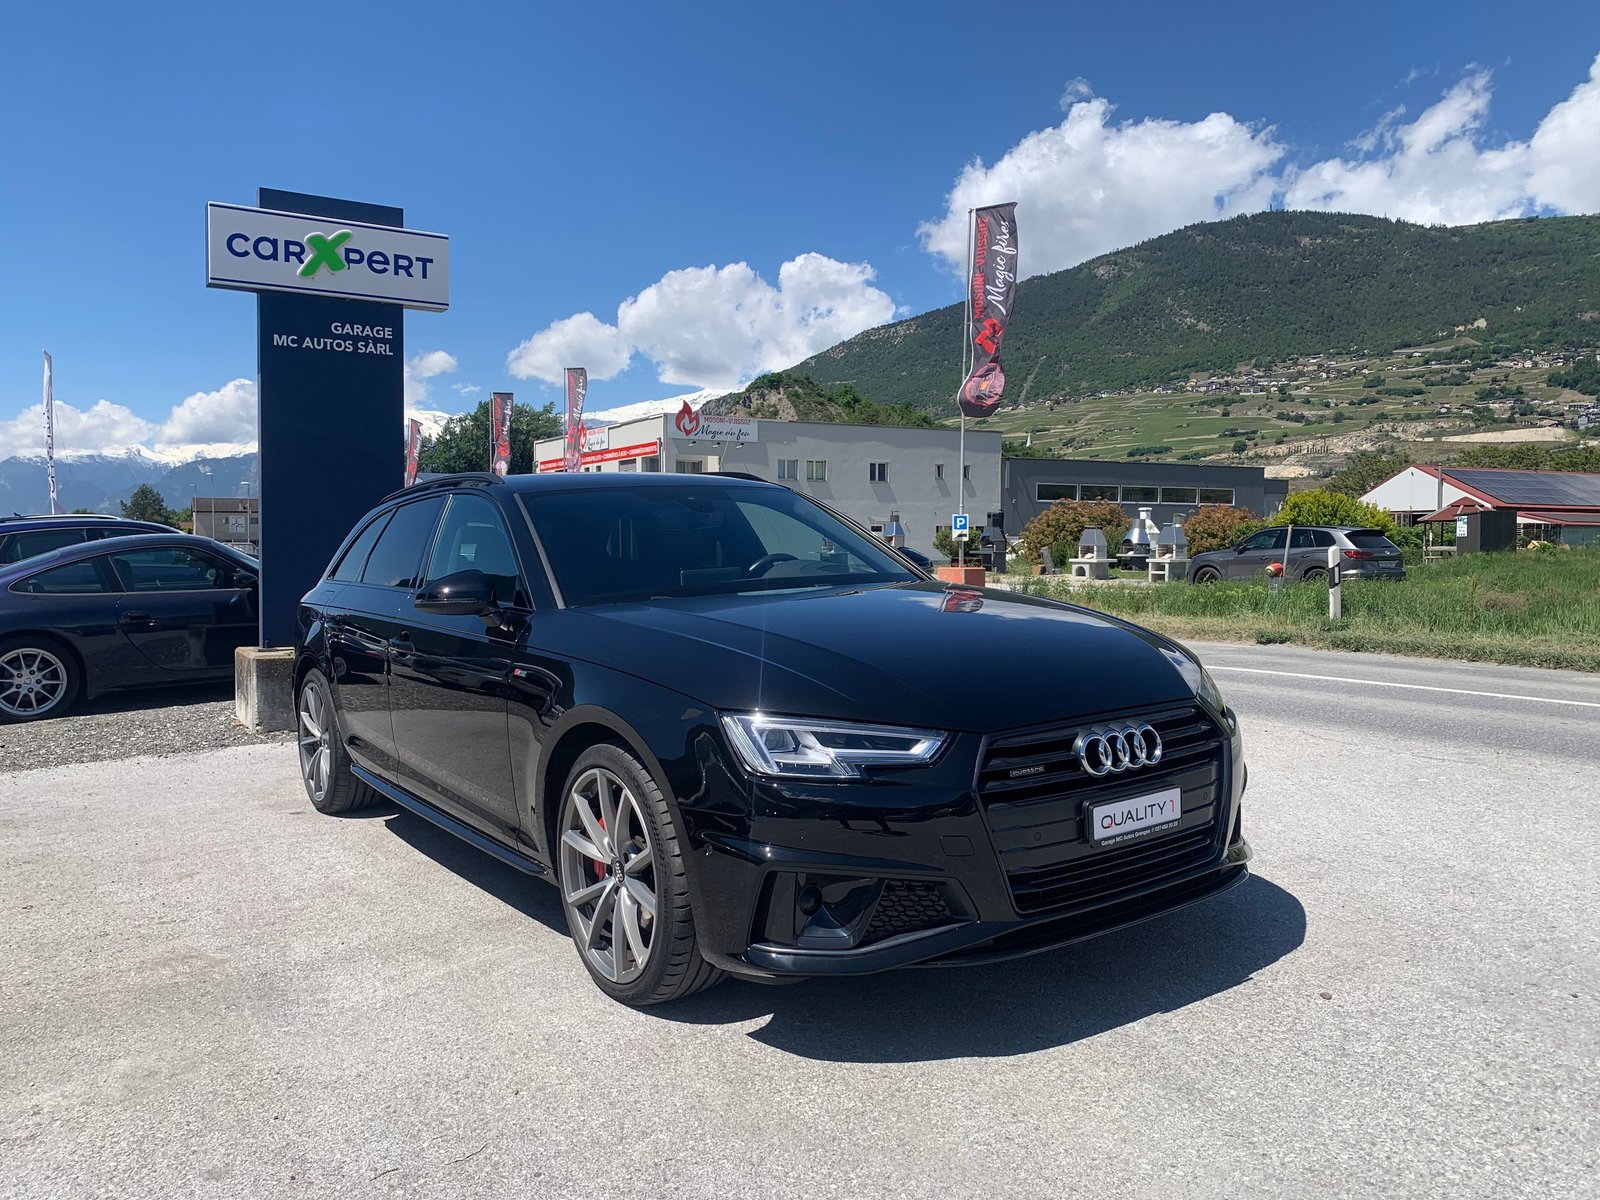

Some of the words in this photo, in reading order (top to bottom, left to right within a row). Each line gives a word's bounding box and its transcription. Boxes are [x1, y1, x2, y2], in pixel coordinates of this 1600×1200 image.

[991, 221, 1017, 254] fires
[985, 255, 1014, 316] Magic
[330, 322, 393, 339] GARAGE
[273, 334, 298, 348] MC
[302, 337, 354, 352] AUTOS
[357, 339, 394, 356] SÀRL
[694, 424, 724, 439] Magie
[725, 427, 736, 437] du
[736, 428, 751, 440] feu
[957, 517, 966, 529] P
[1101, 800, 1167, 830] QUALITY
[1101, 838, 1116, 846] Garage
